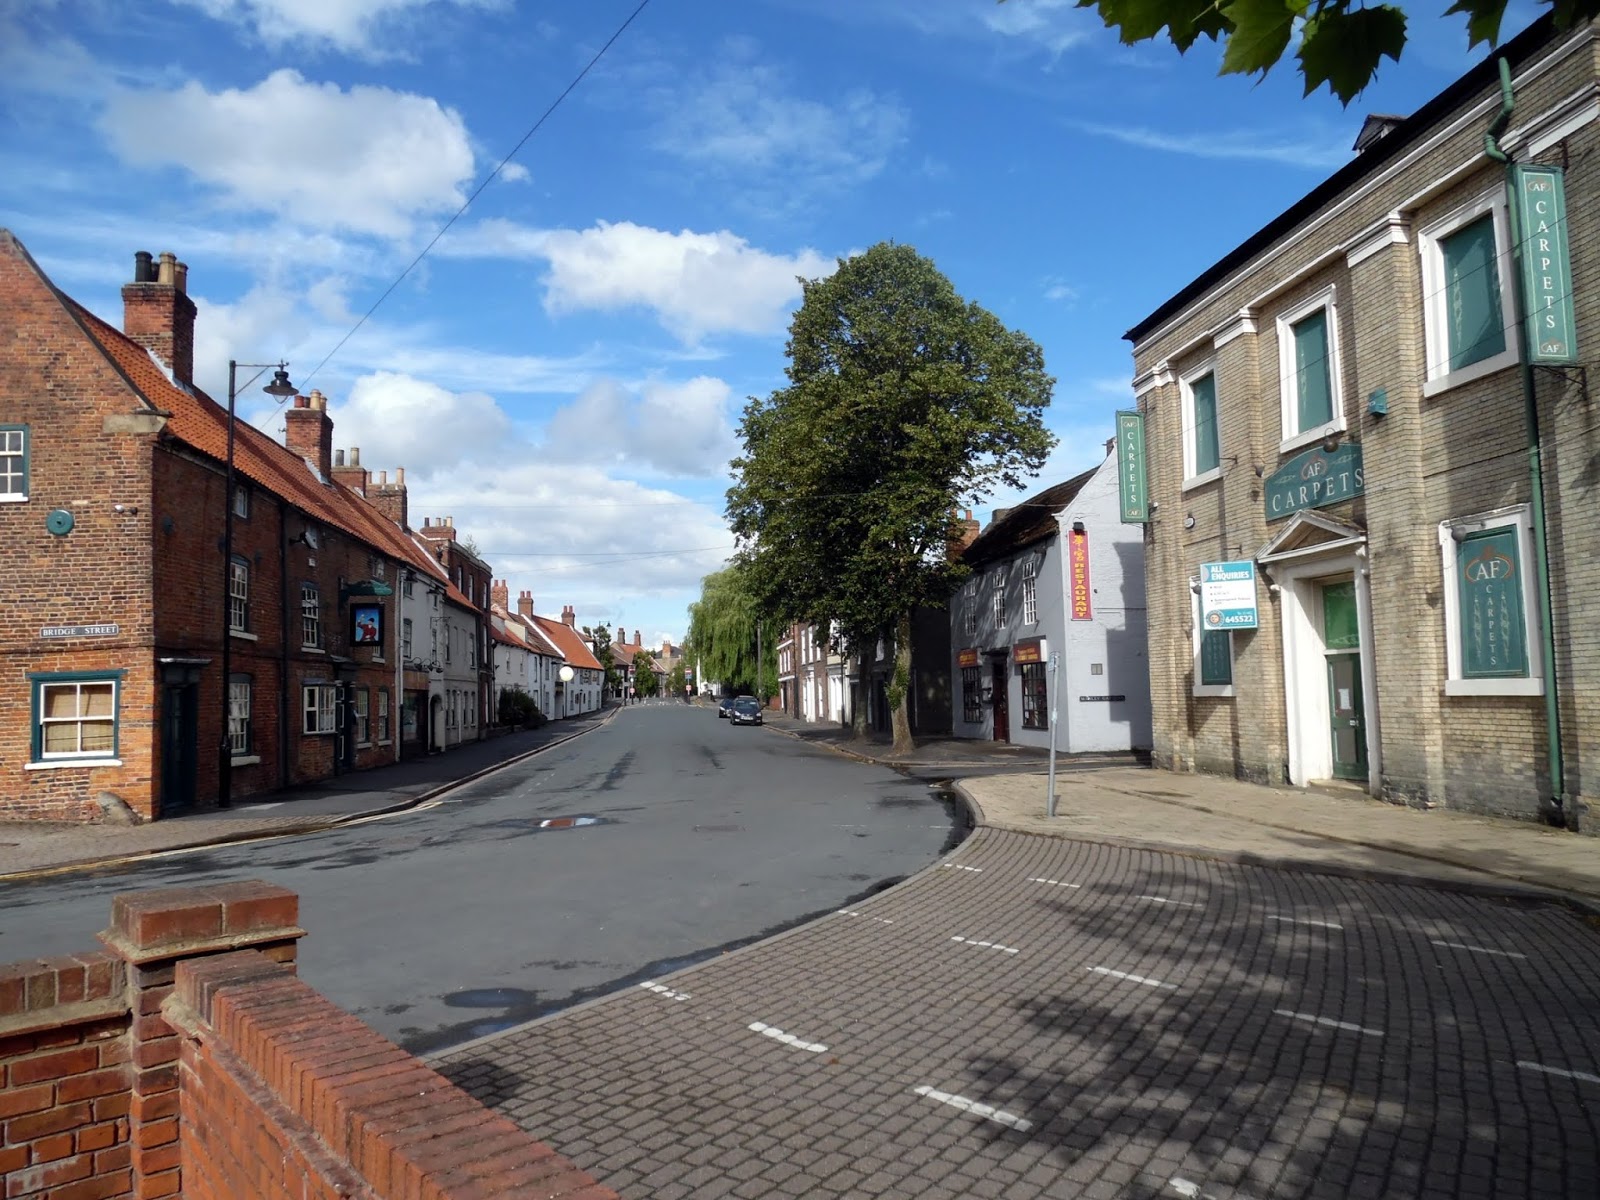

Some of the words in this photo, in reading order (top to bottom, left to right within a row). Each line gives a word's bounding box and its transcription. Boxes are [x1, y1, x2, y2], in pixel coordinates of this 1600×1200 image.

[1533, 183, 1547, 191] AF
[1535, 200, 1556, 329] CARPETS
[1546, 344, 1560, 353] AF
[1127, 432, 1137, 503] CARPETS
[1307, 462, 1321, 478] AF
[1272, 468, 1363, 512] CARPETS
[1210, 565, 1224, 573] ALL
[1211, 571, 1250, 580] ENQUIRIES
[1476, 560, 1501, 581] AF
[1074, 562, 1088, 618] RESTAURANT
[1225, 615, 1253, 623] 645522
[1485, 584, 1497, 666] CARPETS
[42, 628, 76, 636] BRIDGE
[84, 626, 116, 634] STREET
